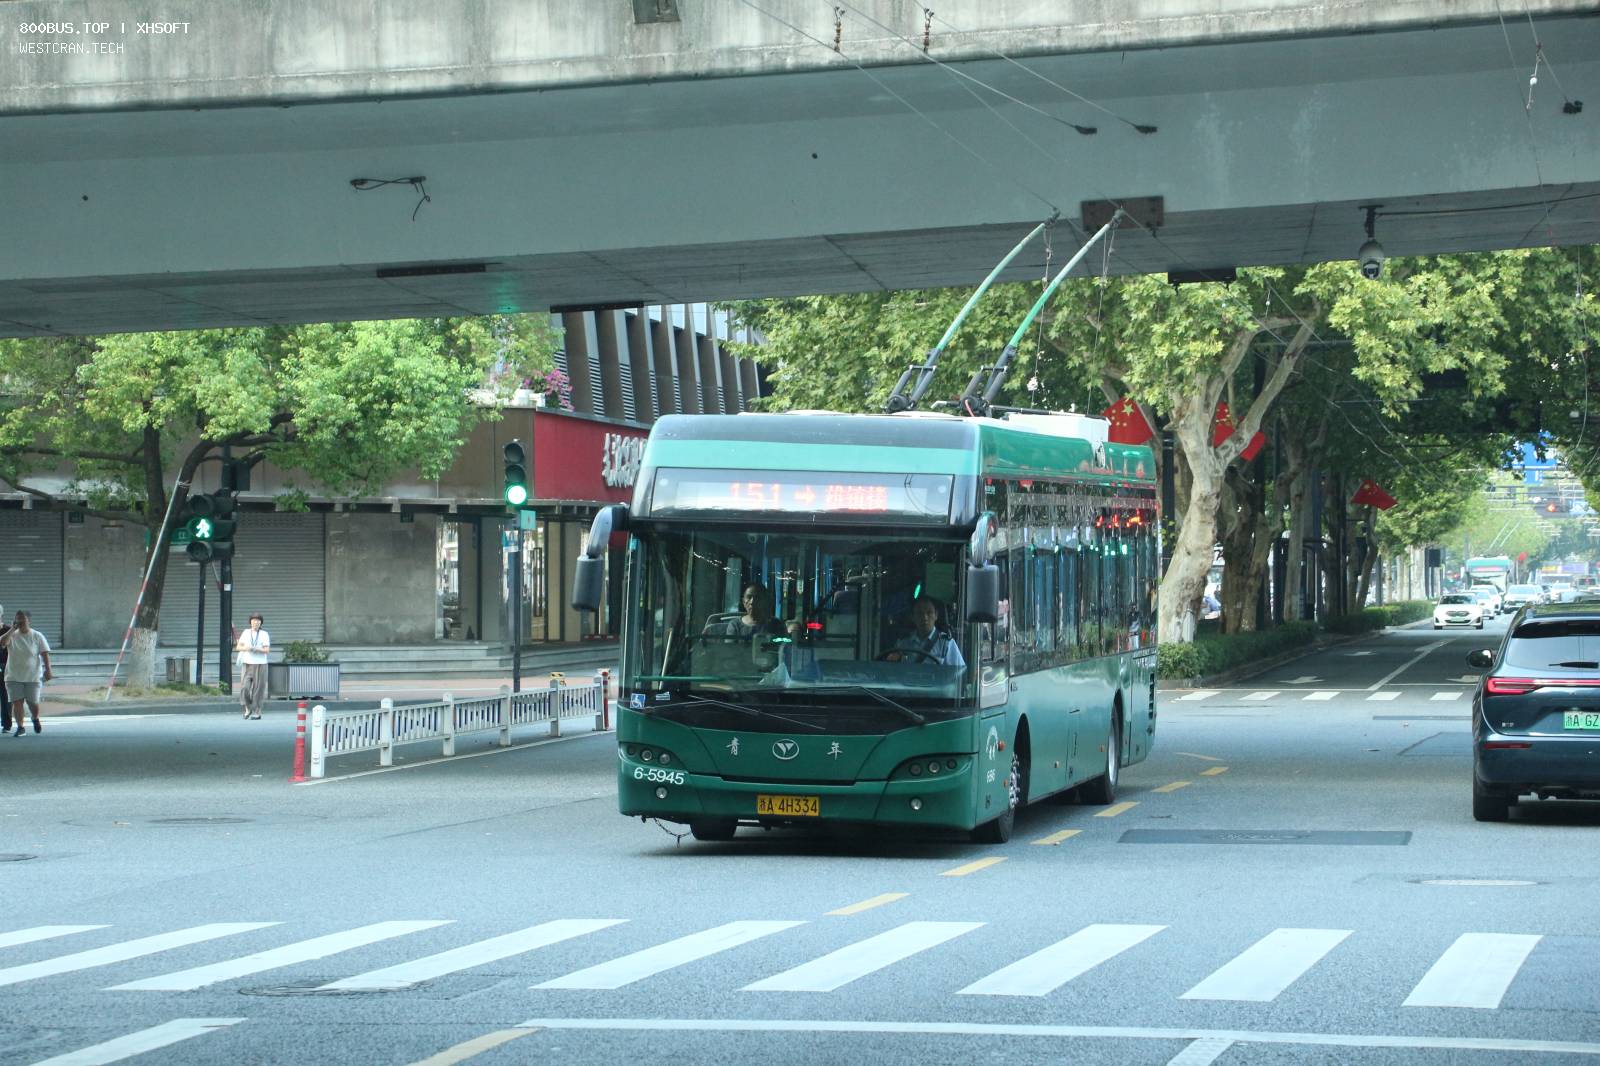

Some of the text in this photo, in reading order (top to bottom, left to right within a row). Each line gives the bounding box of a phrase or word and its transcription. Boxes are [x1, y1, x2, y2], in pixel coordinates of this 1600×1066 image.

[730, 482, 780, 510] 151
[726, 737, 843, 760] 青 年
[633, 766, 685, 785] 6-5945
[778, 798, 818, 813] 4H334
